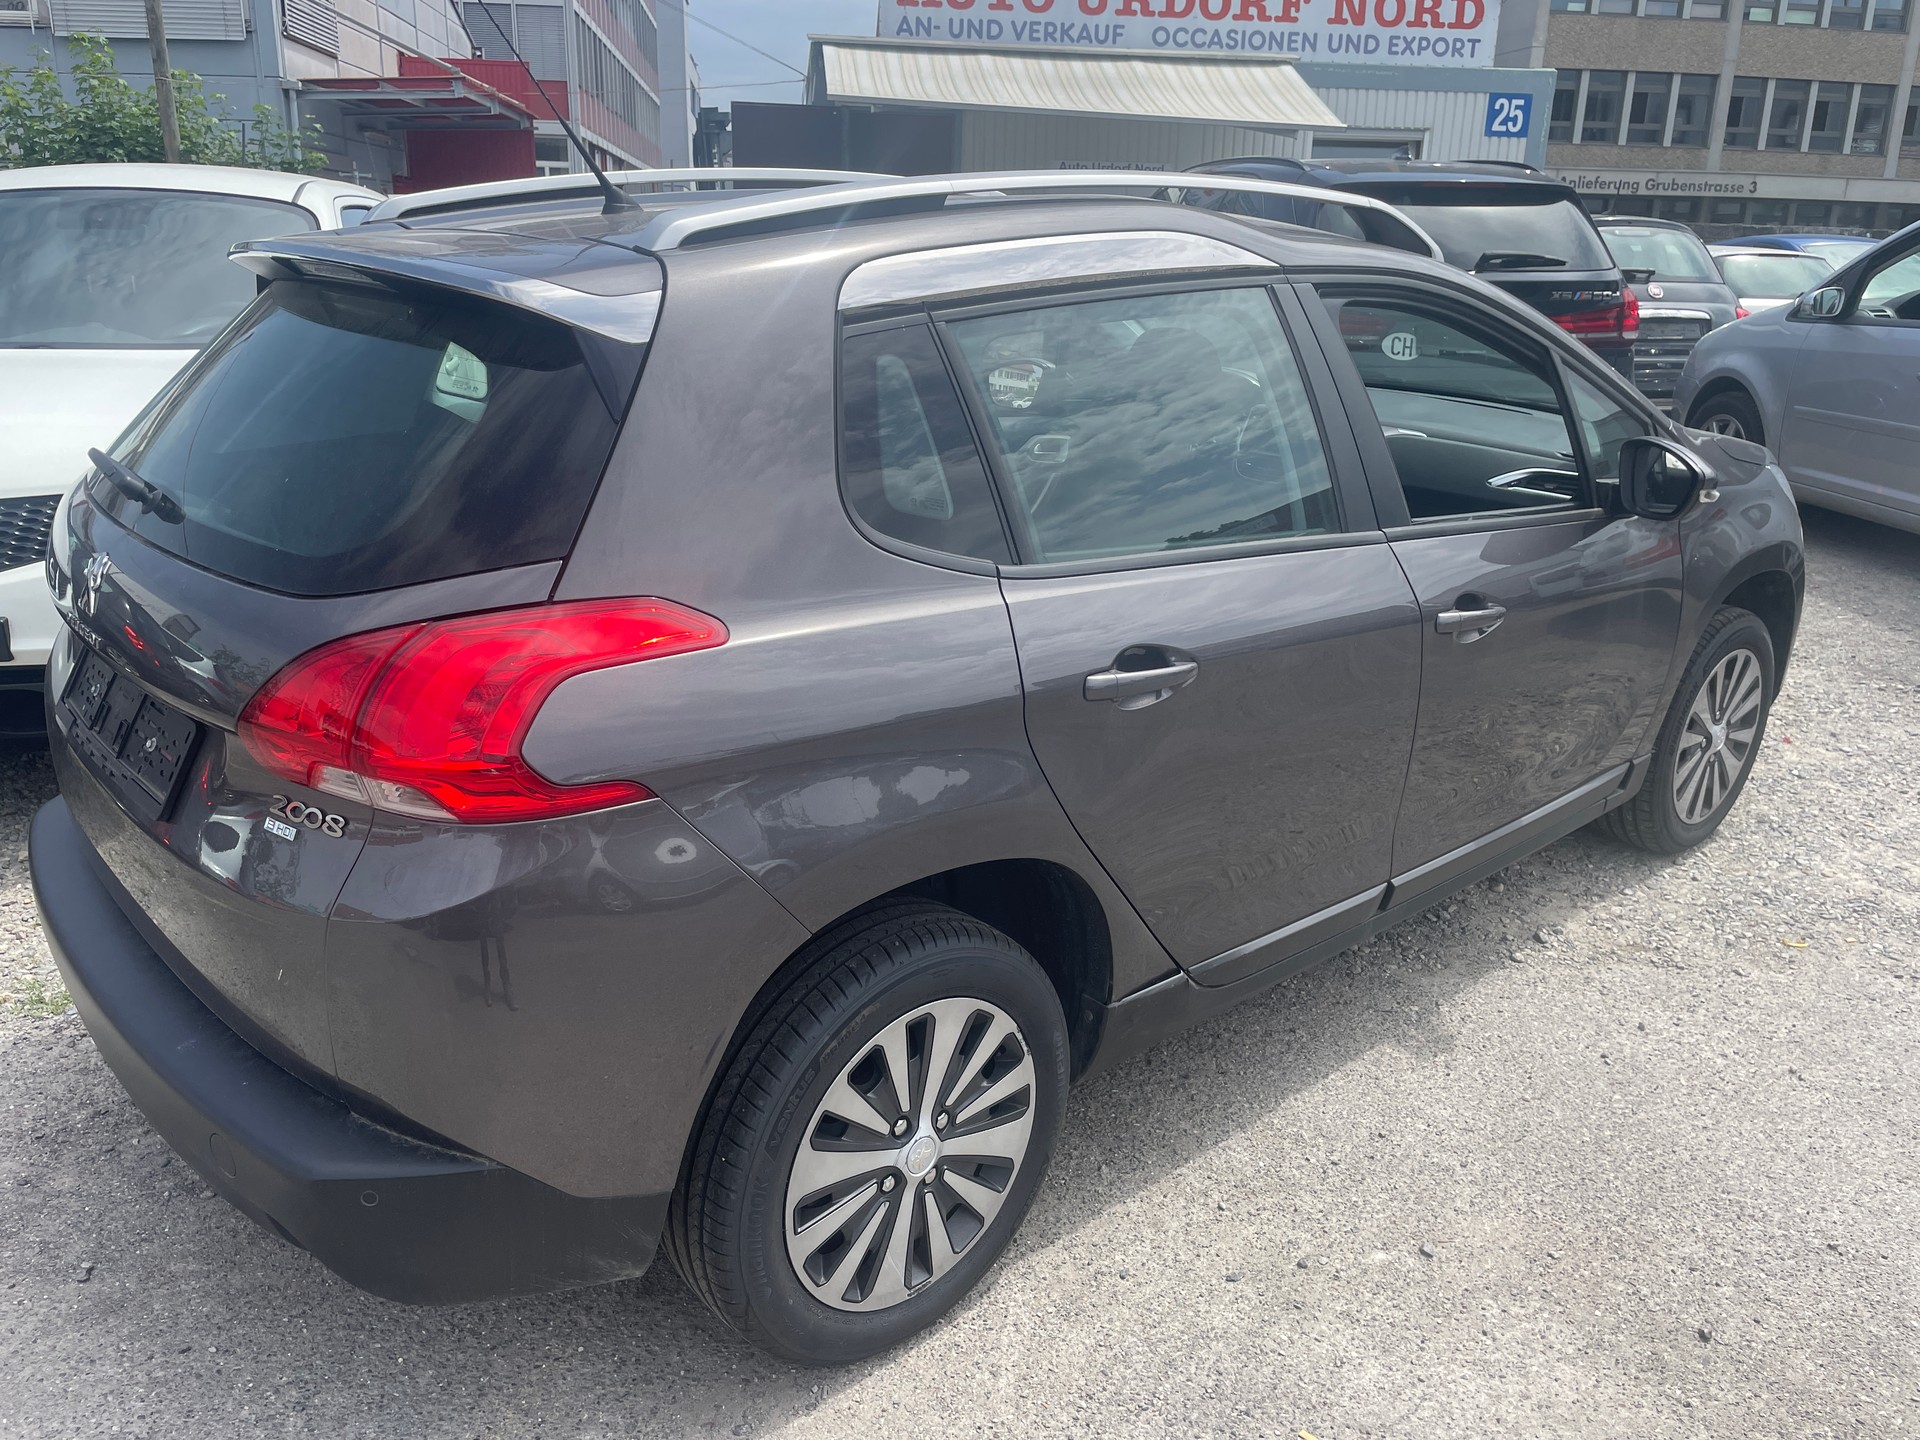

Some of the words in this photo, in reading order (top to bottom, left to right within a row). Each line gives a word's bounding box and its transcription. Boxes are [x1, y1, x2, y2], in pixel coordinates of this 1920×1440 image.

[1327, 0, 1485, 30] NORD
[896, 16, 941, 37] AN-
[949, 18, 1003, 40] UND
[1011, 20, 1125, 45] VERKAUF
[1152, 26, 1318, 52] OCCASIONEN
[1327, 33, 1380, 54] UND
[1388, 35, 1481, 58] EXPORT
[1492, 98, 1525, 133] 25
[1645, 178, 1744, 193] Grubenstrasse
[1749, 181, 1757, 194] 3
[1391, 336, 1414, 357] CH
[269, 794, 346, 838] 2008
